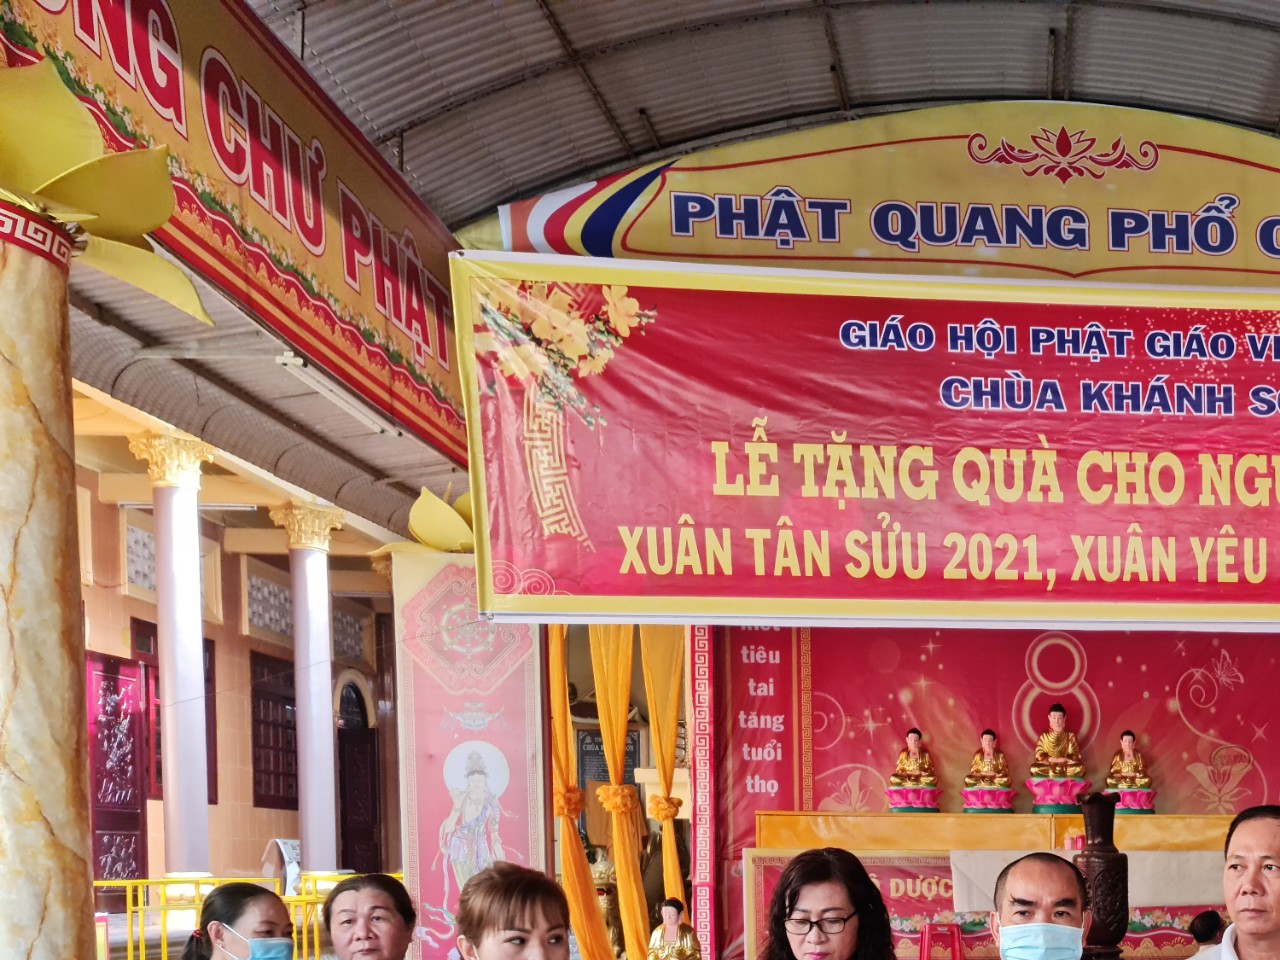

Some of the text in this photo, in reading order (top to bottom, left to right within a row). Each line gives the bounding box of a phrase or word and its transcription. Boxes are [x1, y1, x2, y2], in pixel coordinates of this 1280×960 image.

[37, 0, 451, 374] NG CHƯ PHẬT
[670, 185, 852, 250] PHẬT
[870, 200, 1090, 254] QUANG
[1107, 193, 1241, 256] PHỔ
[839, 315, 935, 352] GIÁO
[947, 317, 1016, 359] HỘI
[1029, 322, 1132, 359] PHẬT
[1144, 323, 1236, 361] GIÁO
[938, 370, 1067, 413] CHÙA
[1079, 376, 1235, 418] KHÁNH
[712, 416, 780, 498] LỄ
[794, 429, 939, 511] TẶNG
[952, 433, 1064, 505] QUÀ
[1076, 450, 1187, 507] CHO
[618, 513, 734, 576] XUÂN
[745, 515, 830, 577] TÂN
[844, 511, 929, 579] SỬU
[943, 532, 1057, 591] 2021,
[1071, 523, 1178, 583] XUÂN
[1189, 526, 1275, 584] YÊU
[740, 644, 782, 665] tiêu
[747, 677, 775, 697] tai
[738, 707, 785, 733] tăng
[741, 738, 783, 764] tuổi
[744, 773, 779, 798] thọ
[889, 874, 953, 901] DƯỢC
